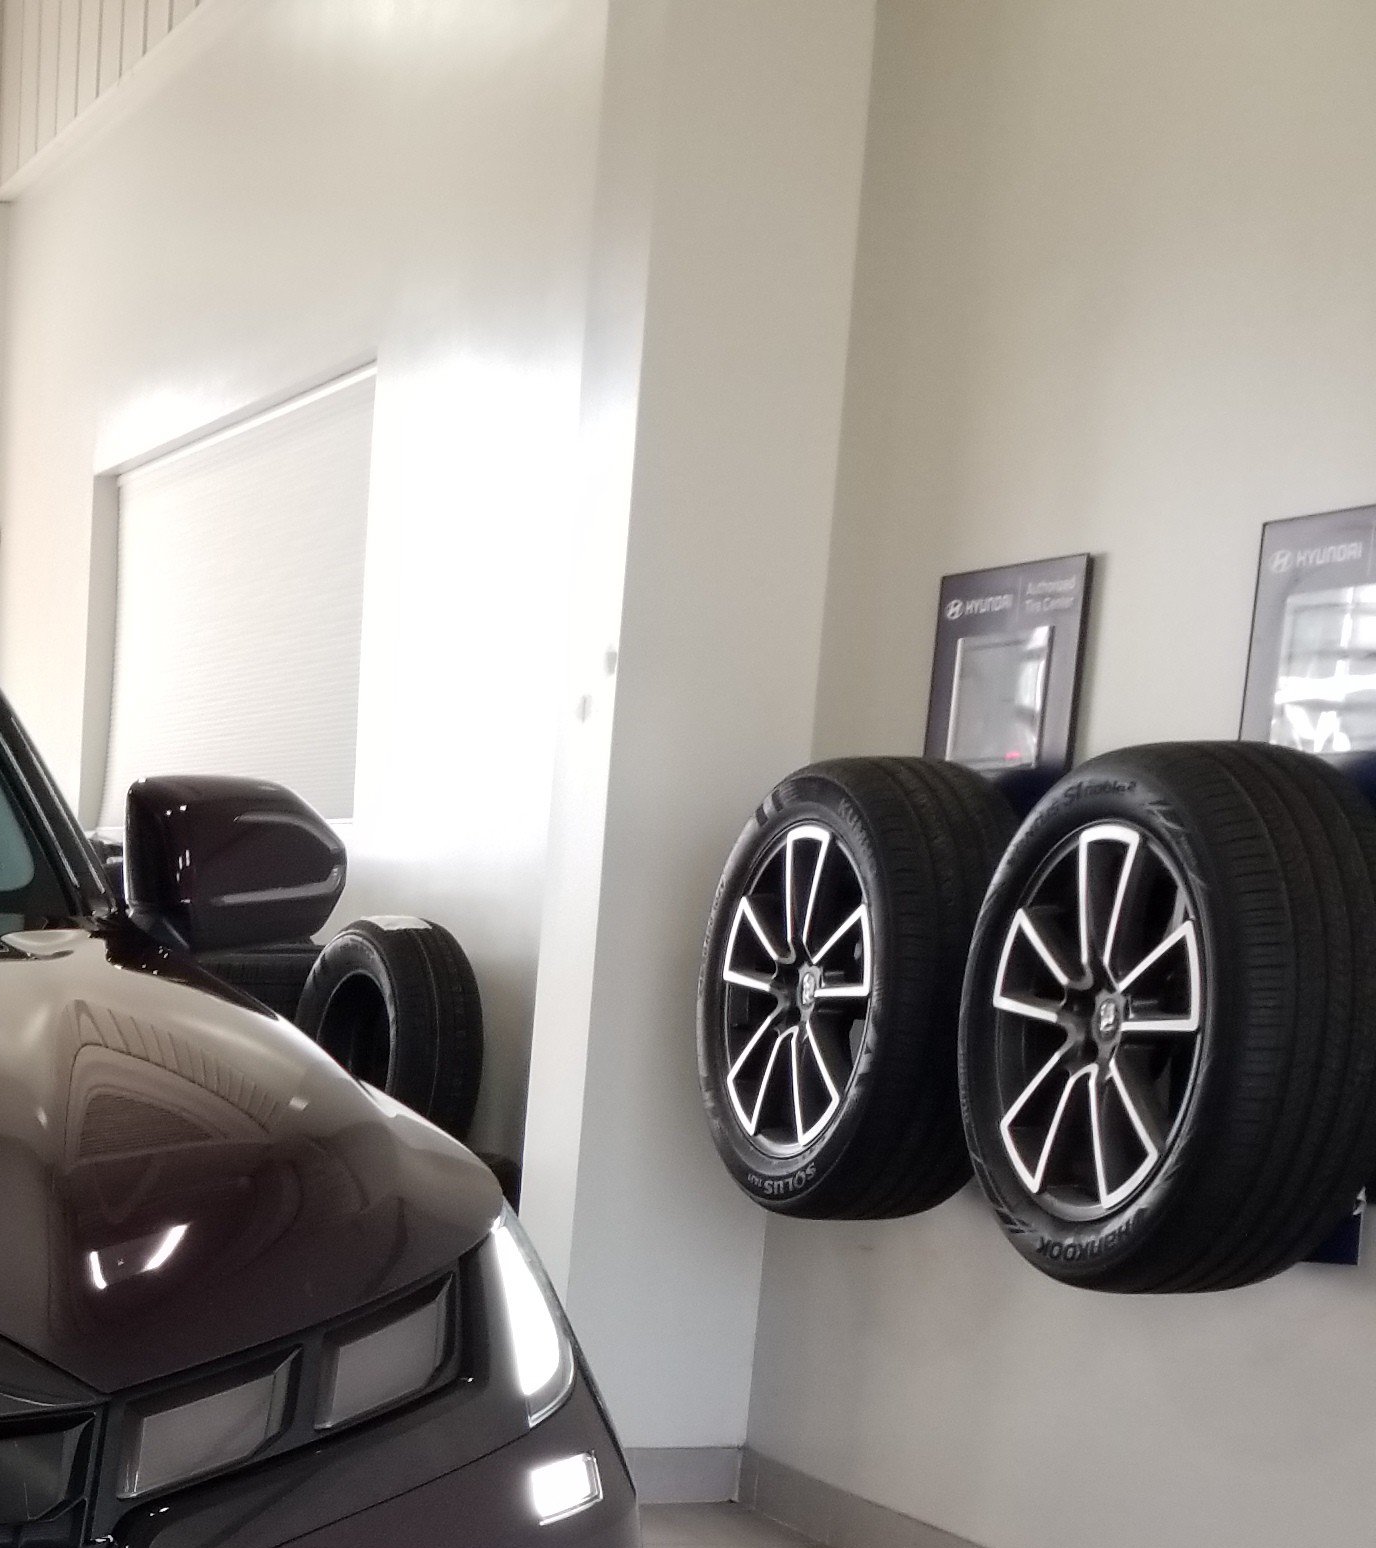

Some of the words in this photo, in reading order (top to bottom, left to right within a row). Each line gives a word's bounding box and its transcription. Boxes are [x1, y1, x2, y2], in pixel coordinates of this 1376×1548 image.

[1295, 542, 1363, 568] HYUNDAI
[965, 594, 1013, 615] HYUNDAI
[763, 1162, 817, 1195] SOLUS
